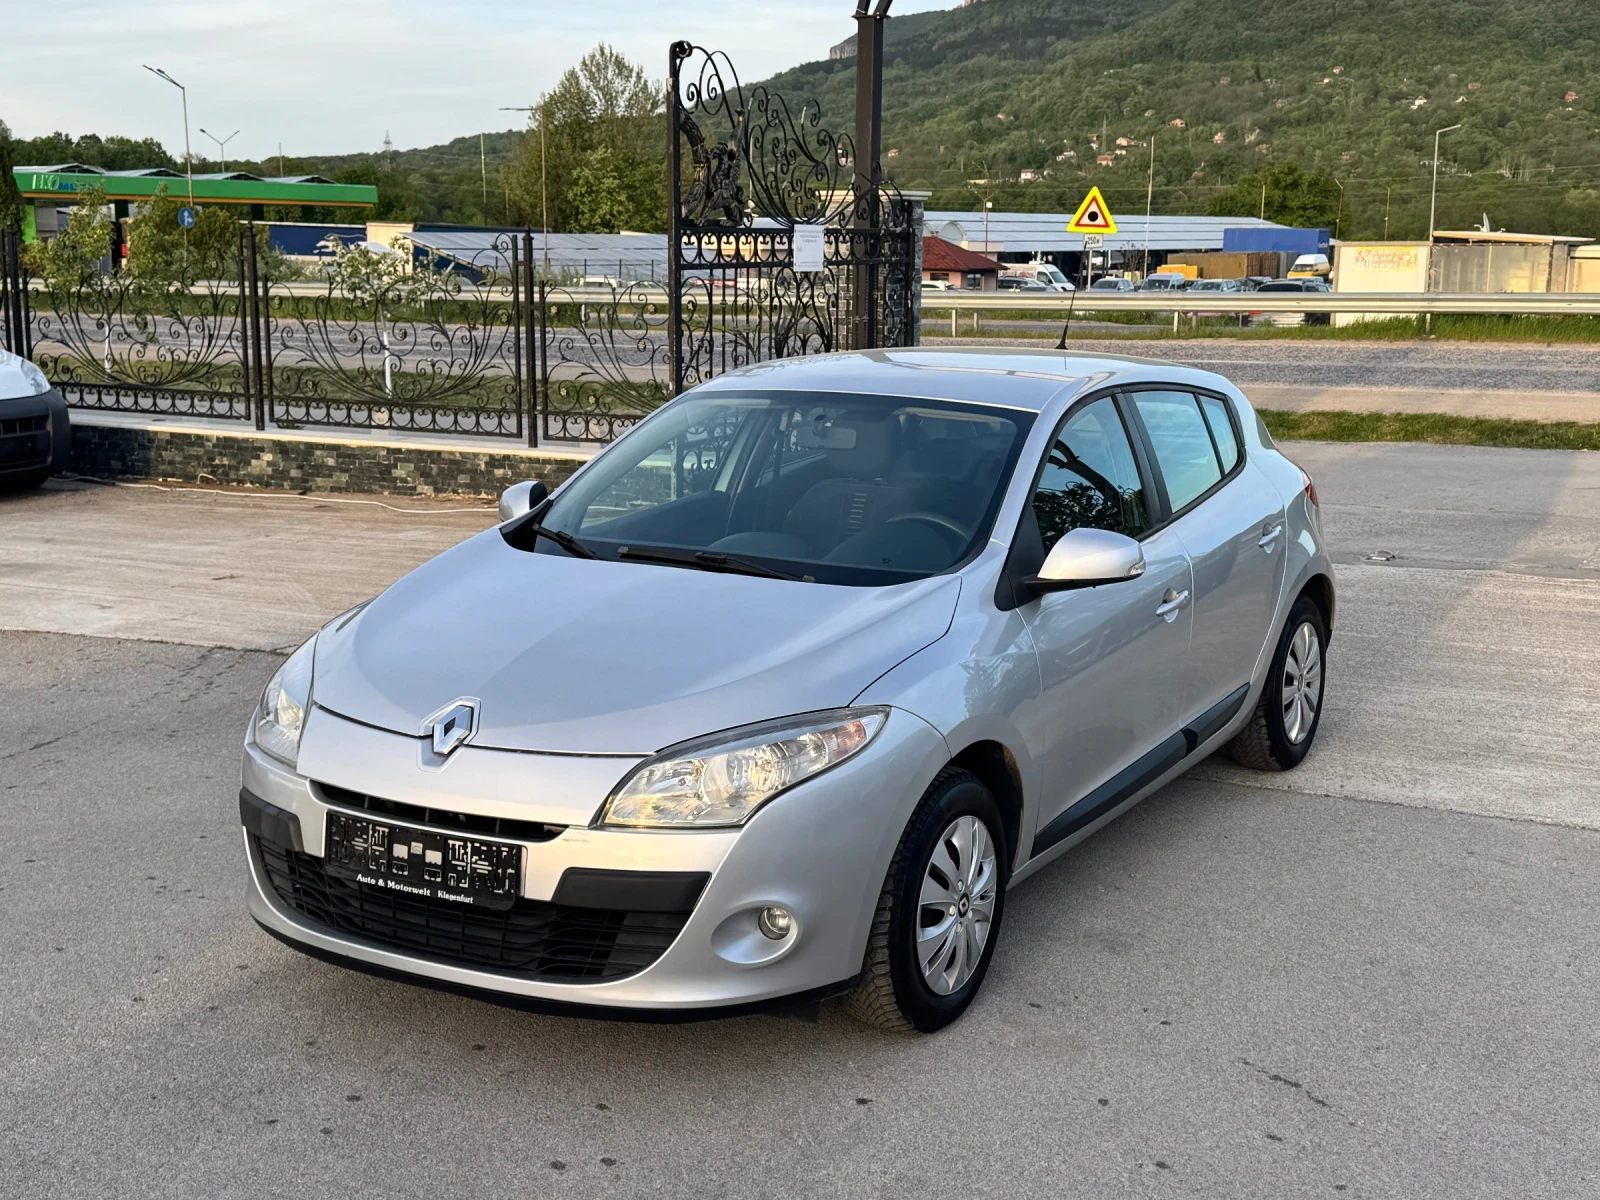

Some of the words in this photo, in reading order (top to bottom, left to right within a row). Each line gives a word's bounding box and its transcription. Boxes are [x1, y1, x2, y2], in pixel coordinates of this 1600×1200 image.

[356, 873, 376, 884] Auto
[378, 878, 386, 887] &
[387, 880, 431, 896] Motorwelt
[437, 890, 474, 904] Klagenfurt
